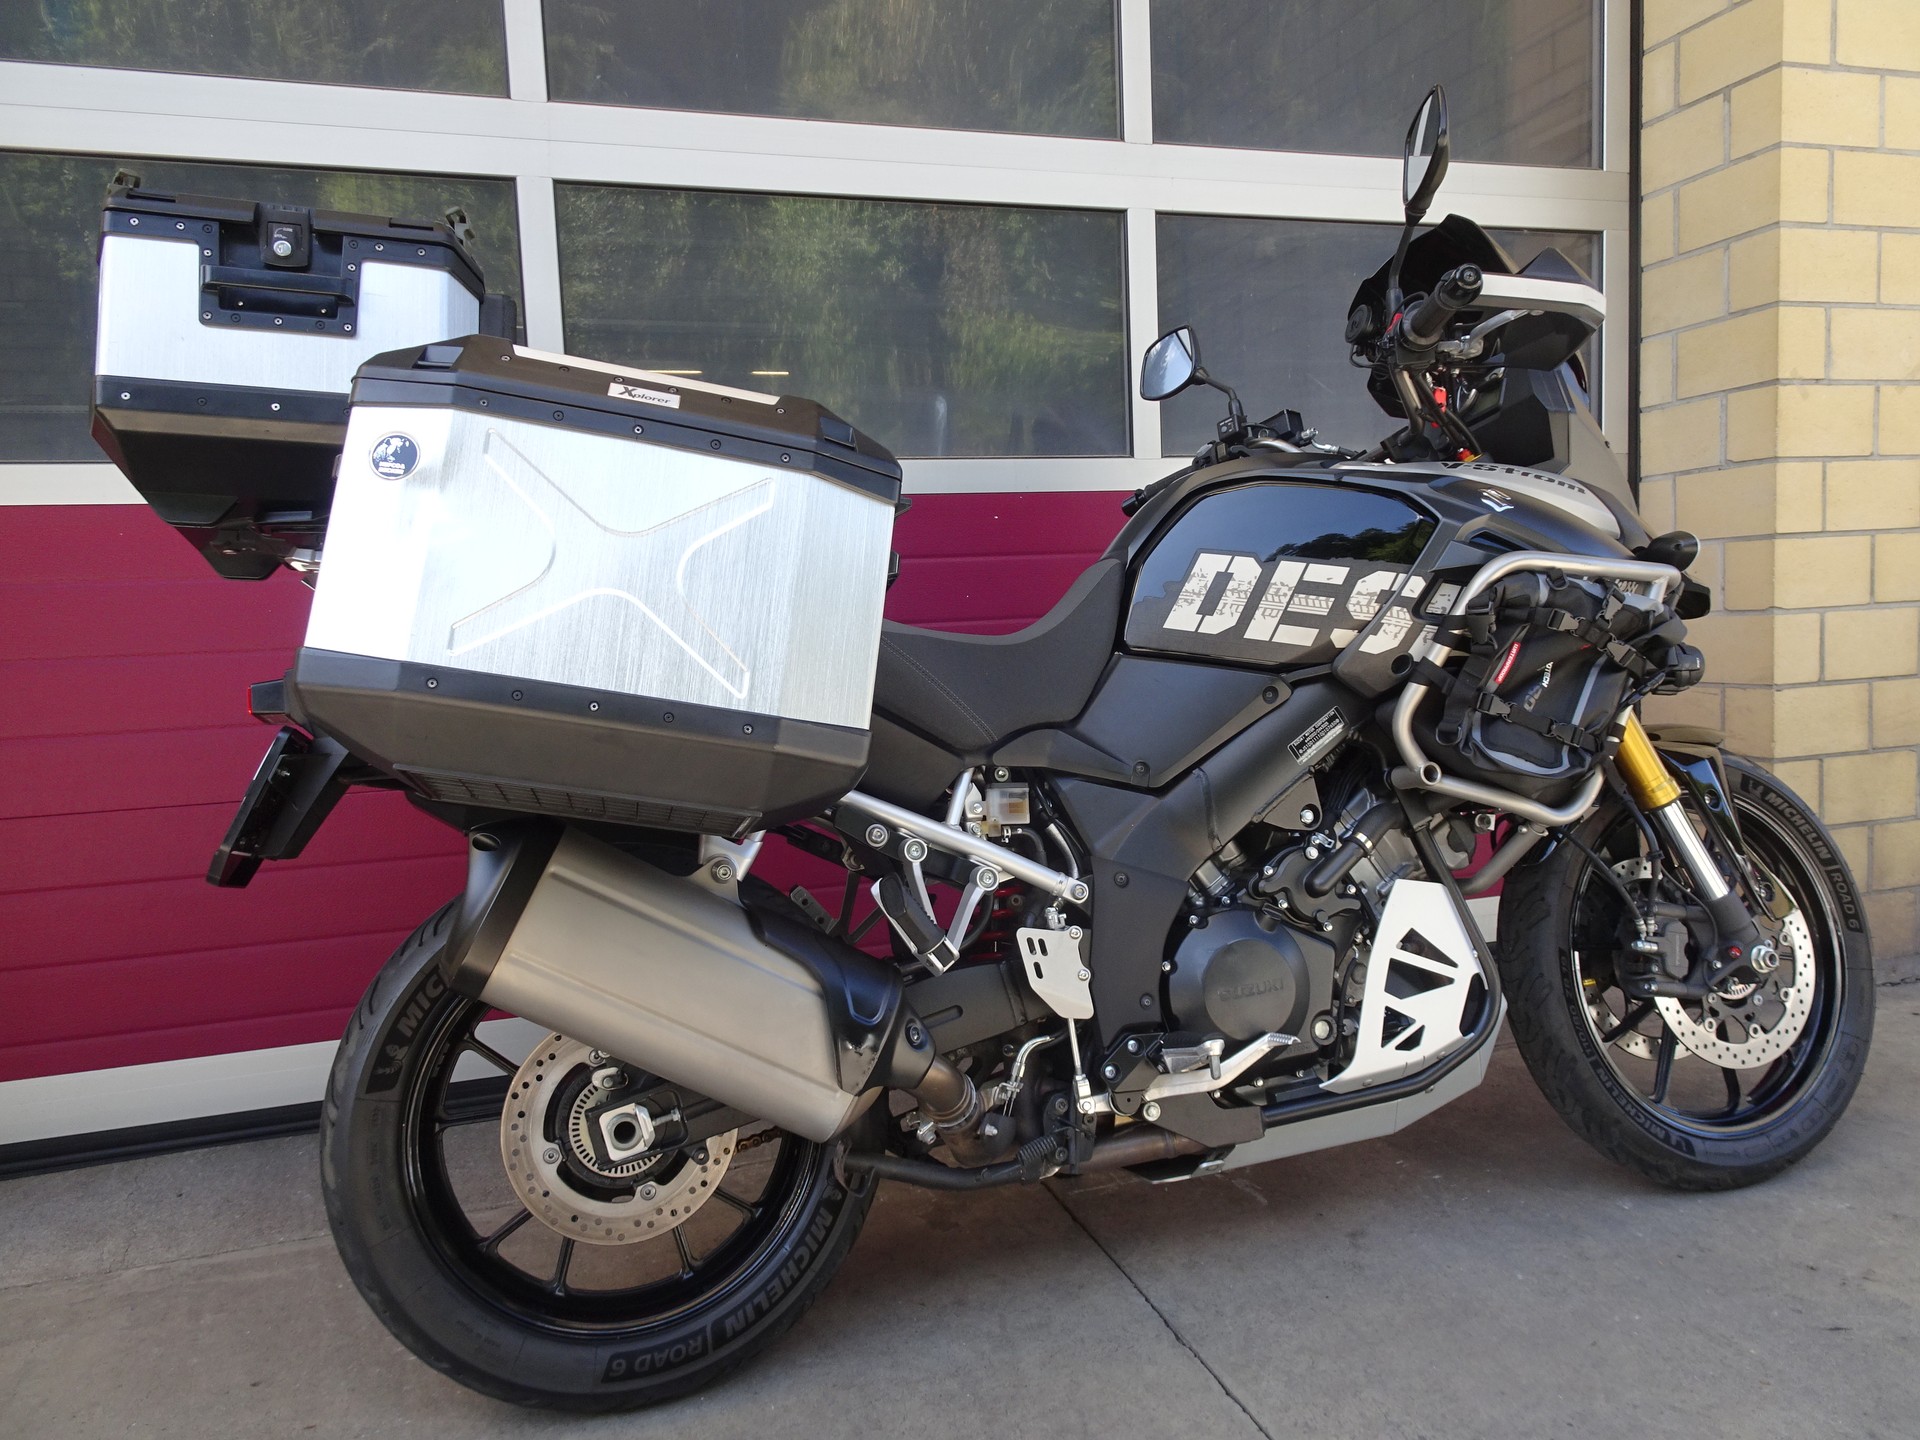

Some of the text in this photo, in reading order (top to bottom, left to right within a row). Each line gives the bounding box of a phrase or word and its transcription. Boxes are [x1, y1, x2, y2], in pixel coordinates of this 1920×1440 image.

[618, 385, 672, 404] Xplorer
[1763, 792, 1860, 931] MICHELIN ROAD 6
[396, 971, 447, 1040] MIC
[608, 1206, 835, 1378] MICHELIN ROAD 6
